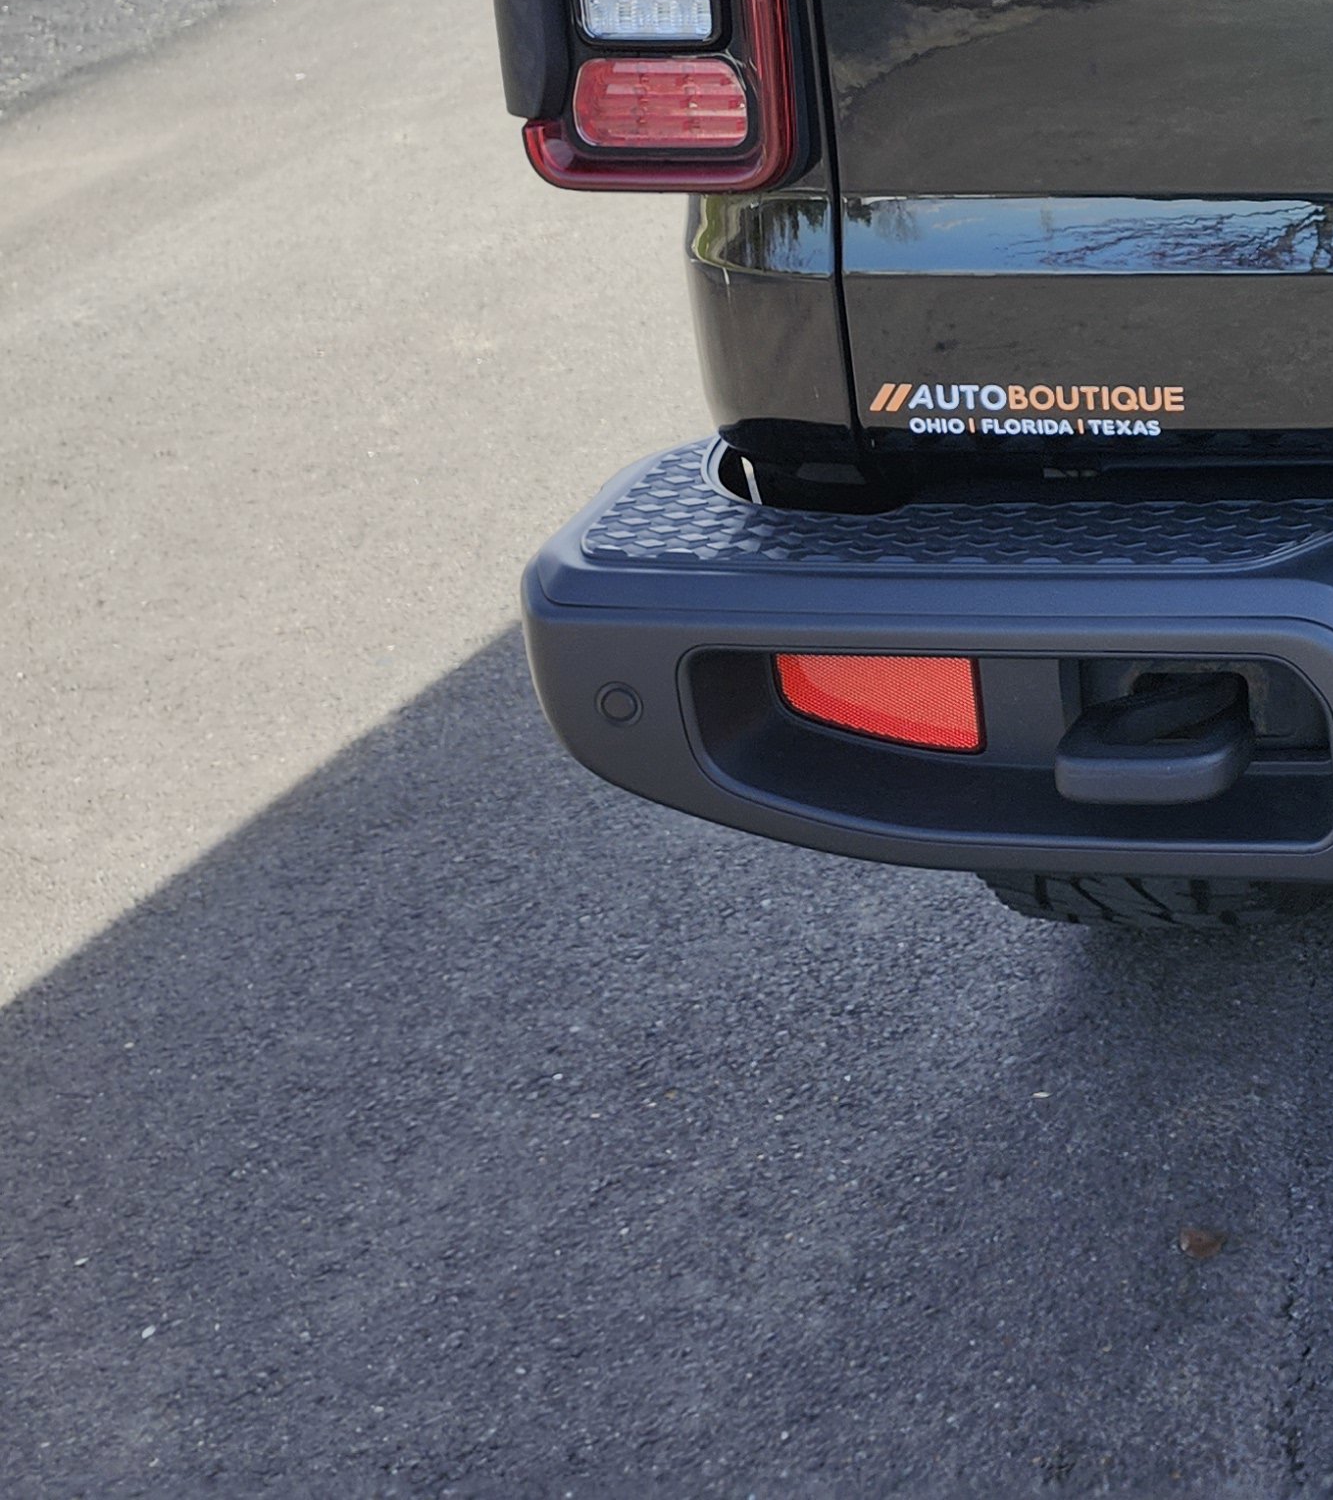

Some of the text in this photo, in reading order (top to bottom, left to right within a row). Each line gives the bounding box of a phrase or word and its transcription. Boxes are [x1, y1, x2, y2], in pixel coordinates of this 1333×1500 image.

[908, 383, 1185, 412] AUTOBOUTIQUE
[909, 416, 1161, 437] OHIO FLORIDA TEXAS
